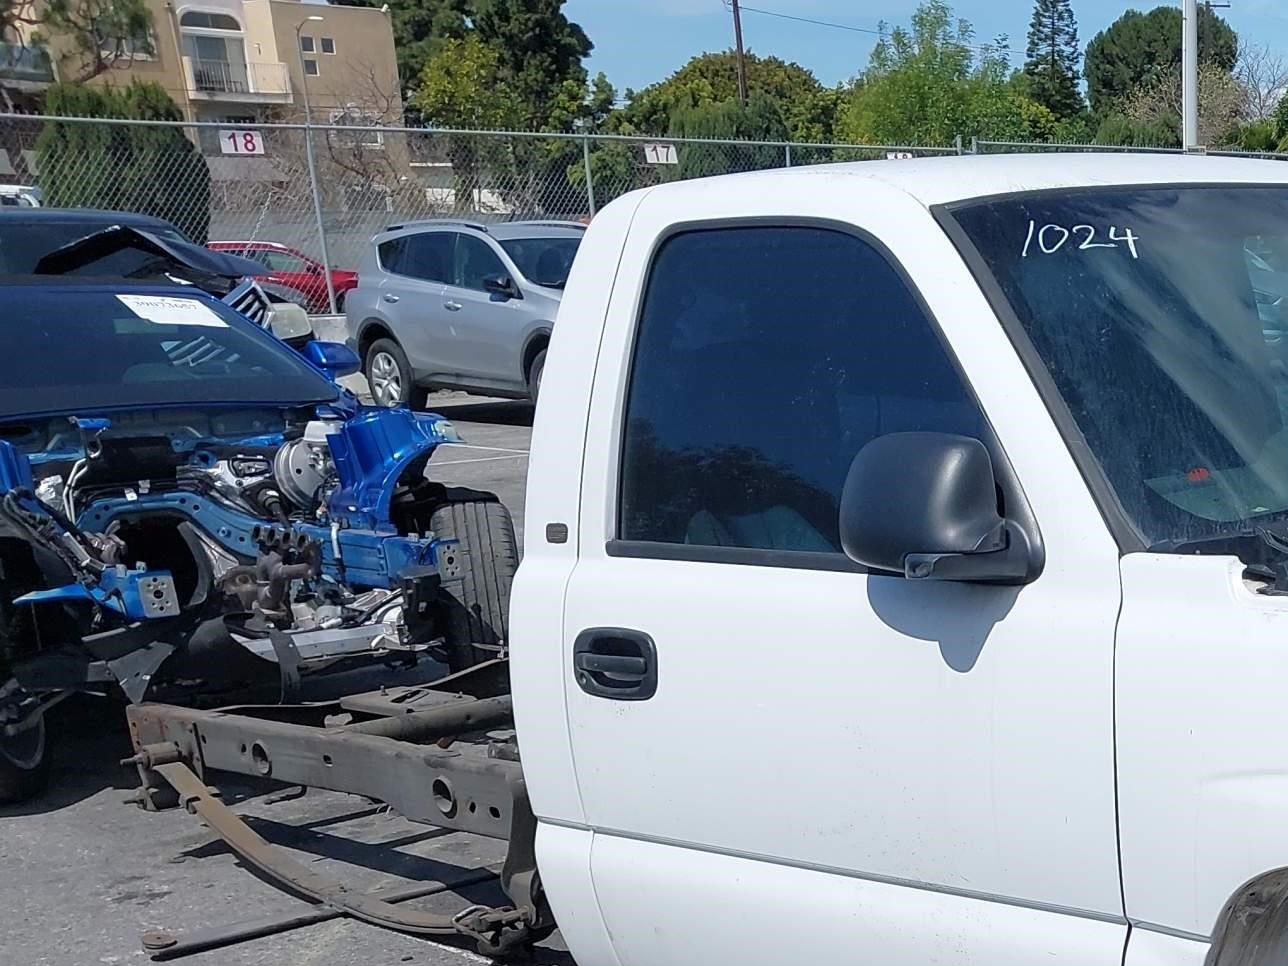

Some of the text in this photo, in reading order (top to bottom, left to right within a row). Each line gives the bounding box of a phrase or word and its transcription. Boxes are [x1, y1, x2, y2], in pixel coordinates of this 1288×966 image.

[228, 132, 256, 152] 18
[651, 145, 671, 162] 17
[1021, 220, 1139, 258] 1024
